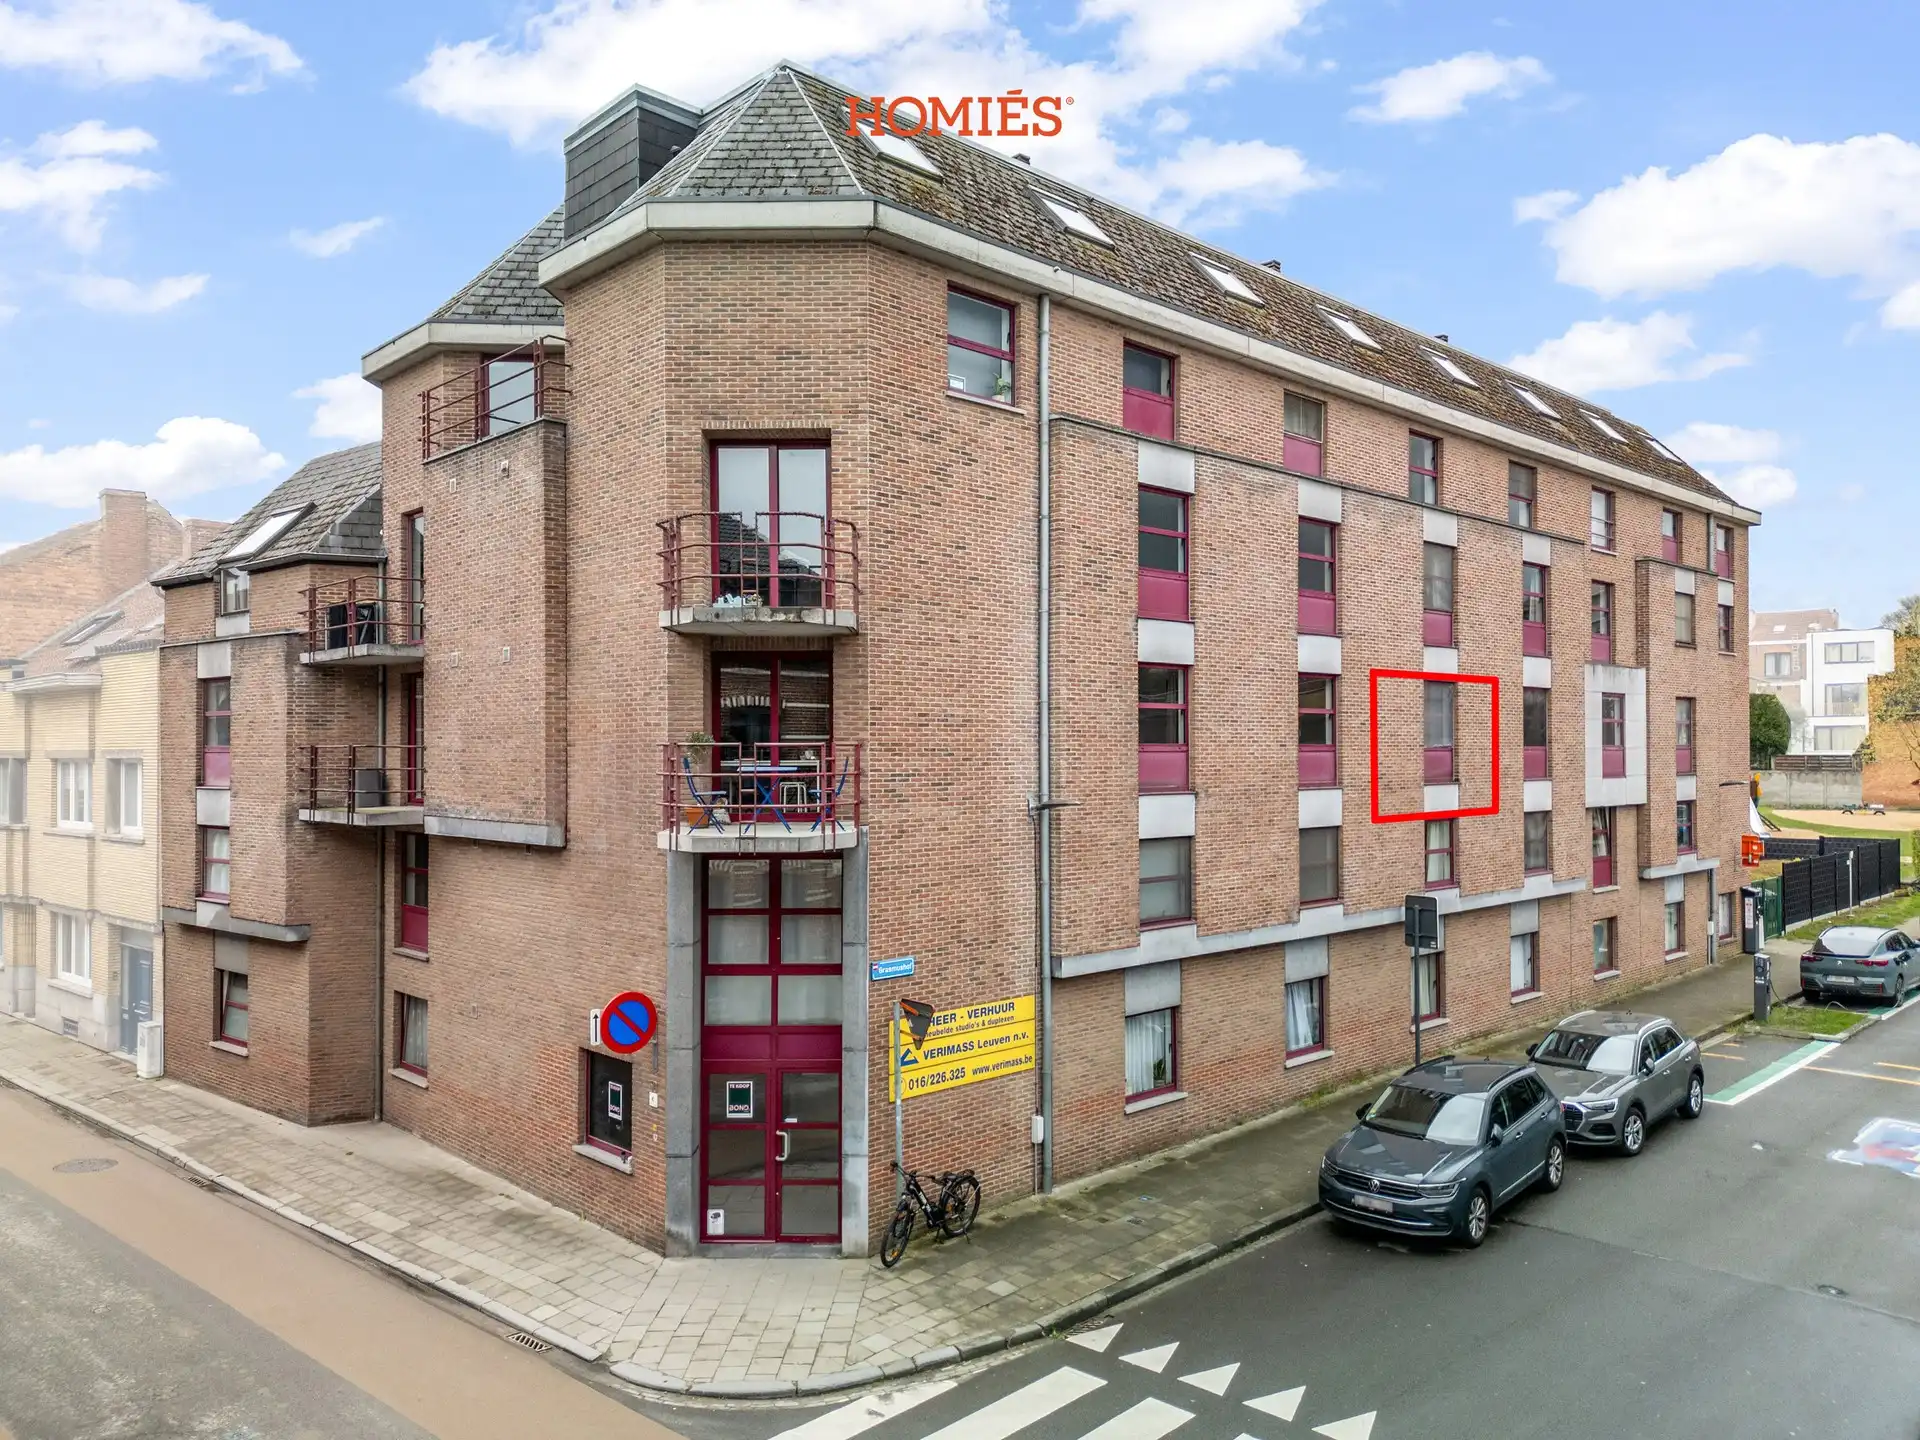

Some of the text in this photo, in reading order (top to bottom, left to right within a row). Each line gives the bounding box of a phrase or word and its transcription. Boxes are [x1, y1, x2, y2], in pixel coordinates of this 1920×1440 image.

[930, 1013, 957, 1027] HEER
[967, 1002, 1015, 1019] VERHUUR
[956, 1021, 980, 1032] studio's
[987, 1015, 1014, 1026] duplexen
[923, 1032, 1029, 1060] VERIMASS Leuven n.v.
[908, 1055, 1033, 1090] 016/226.325 www.verimass.be
